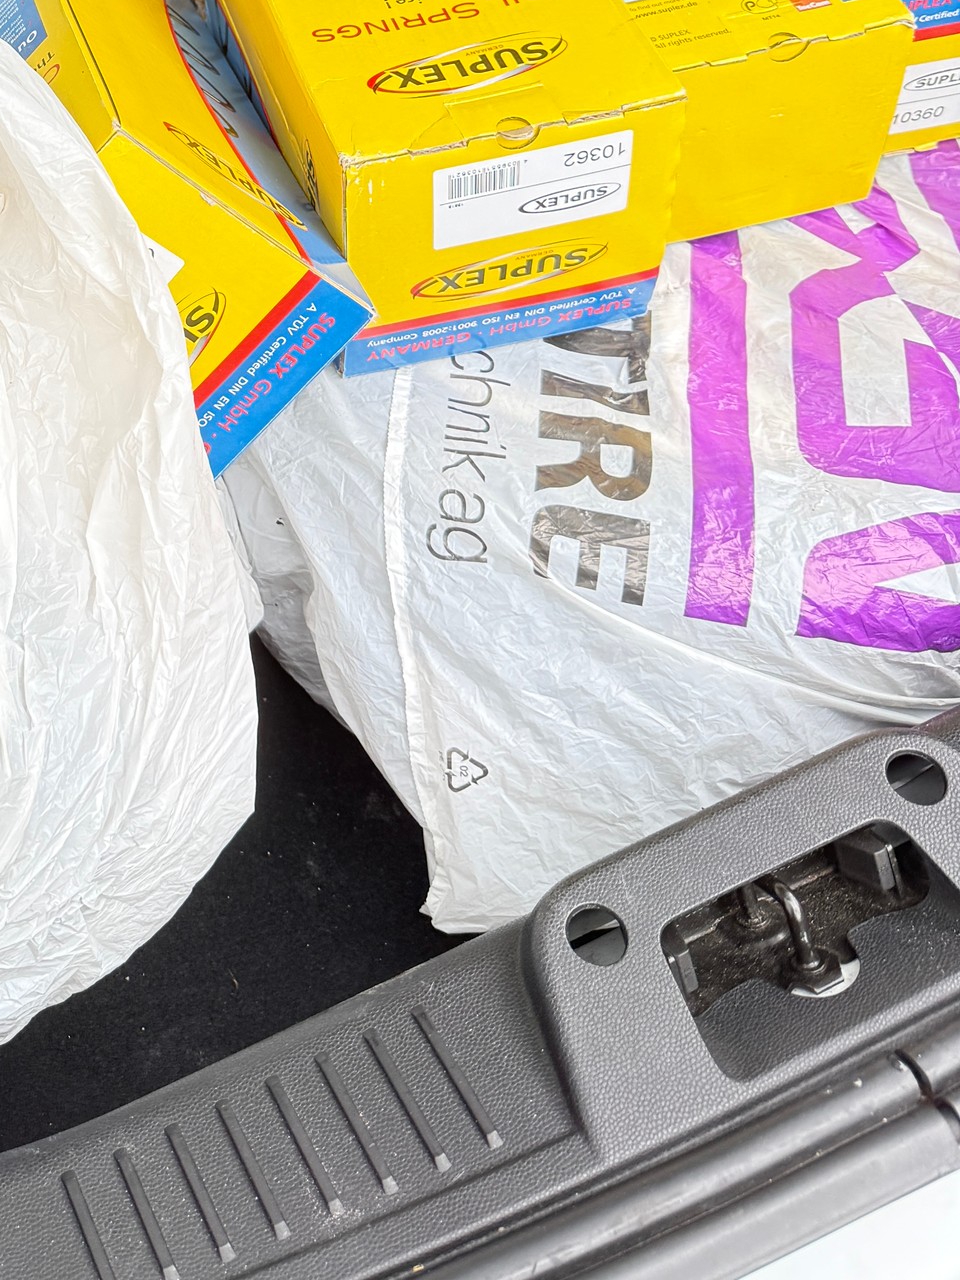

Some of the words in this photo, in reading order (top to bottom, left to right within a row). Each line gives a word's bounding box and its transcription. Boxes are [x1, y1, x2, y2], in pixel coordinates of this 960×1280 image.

[311, 1, 479, 42] SPRINGS
[919, 9, 959, 22] Certified
[657, 28, 691, 40] SUPLEX
[387, 41, 552, 92] SUPLEX
[893, 106, 944, 124] 10360
[563, 142, 625, 167] 10362
[193, 142, 299, 226] SUPLEX
[533, 185, 608, 210] SUPLEX
[434, 247, 587, 292] SUPLEX
[599, 290, 623, 301] TÜV
[627, 286, 636, 294] A
[307, 302, 317, 313] A
[524, 306, 545, 317] DIN
[548, 296, 596, 312] Certified
[561, 298, 631, 325] SUPLEX
[287, 315, 310, 335] TÜV
[481, 315, 500, 325] ISO
[504, 311, 520, 321] EN
[421, 320, 478, 337] 9001:2008
[491, 315, 551, 336] GmbH
[269, 313, 335, 379] SUPLEX
[366, 332, 418, 347] Company
[367, 332, 470, 362] GERMANY
[247, 337, 287, 377] Certified
[228, 377, 249, 395] DIN
[213, 396, 230, 410] EN
[217, 379, 272, 432] GmbH
[199, 412, 215, 427] ISO
[426, 489, 488, 564] ag
